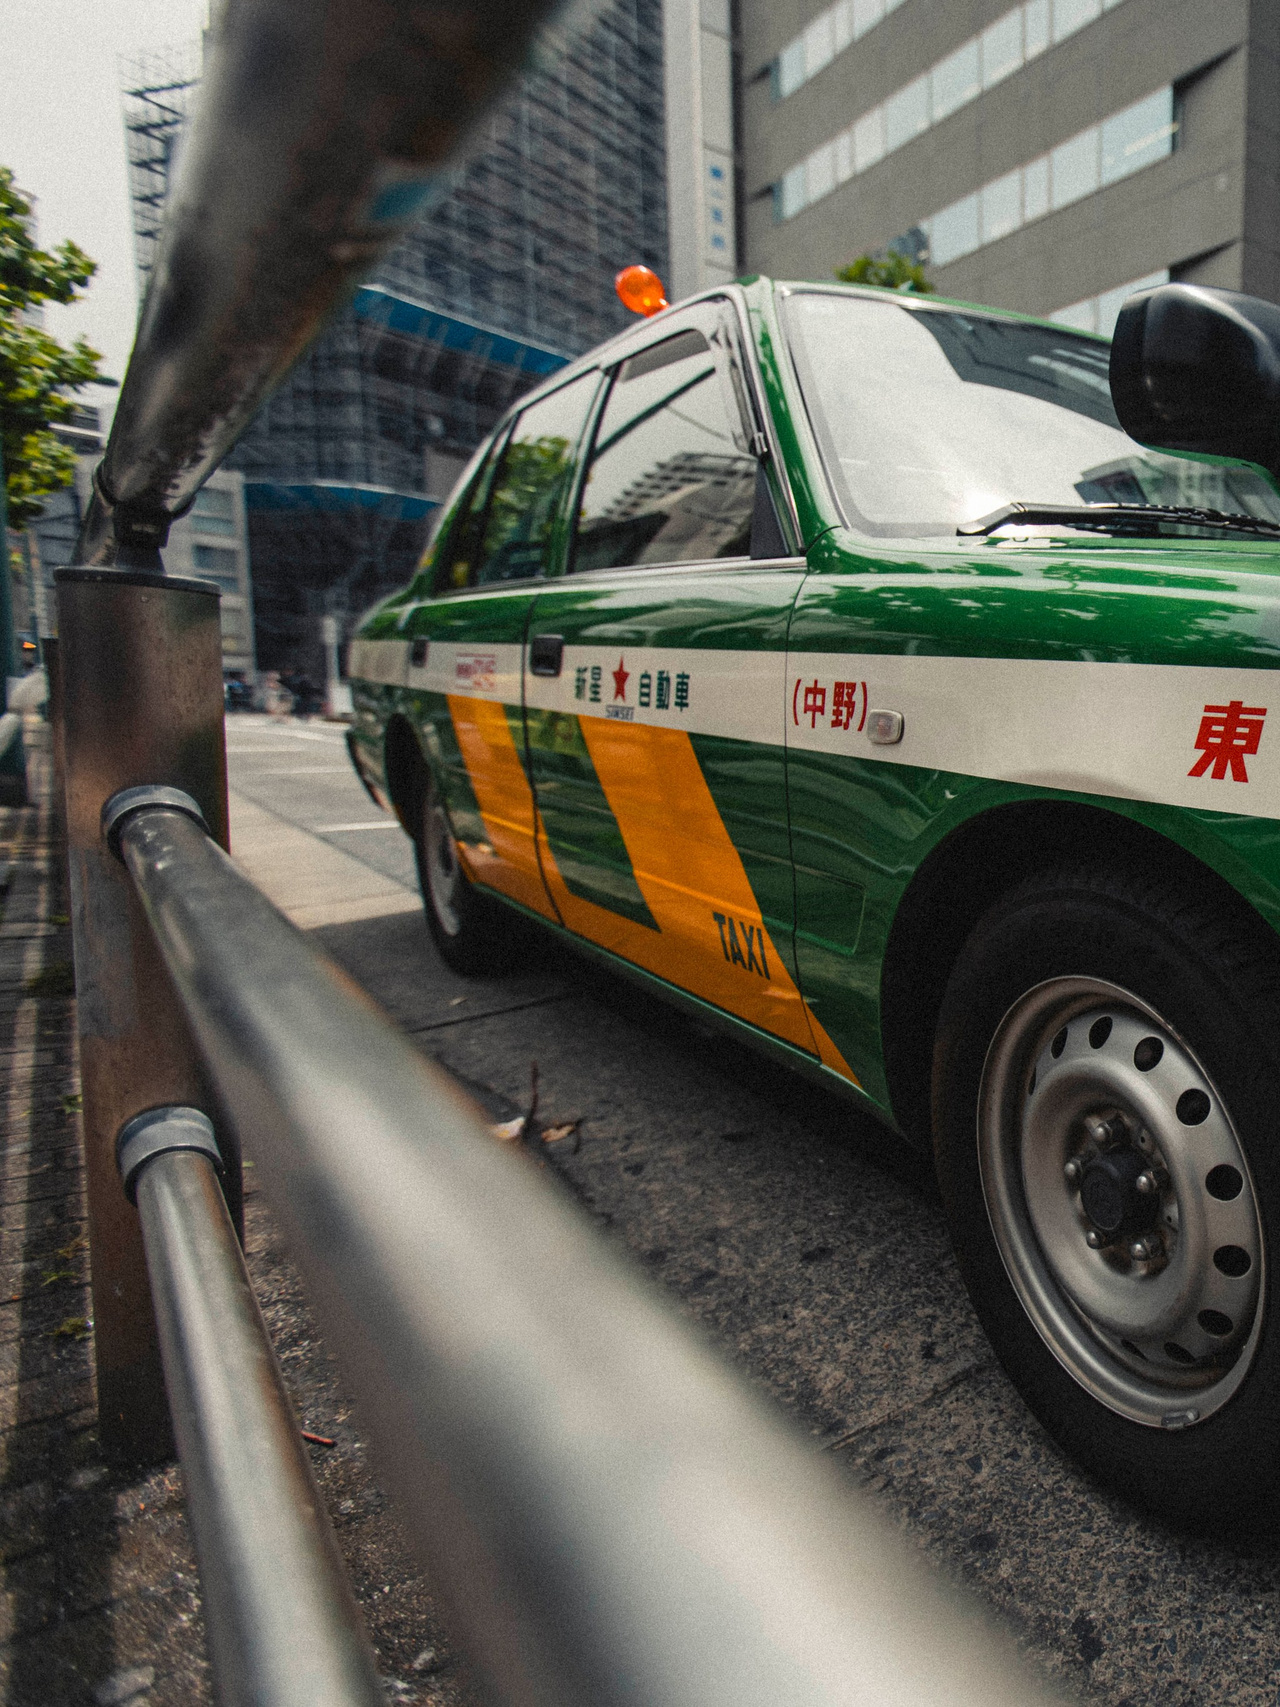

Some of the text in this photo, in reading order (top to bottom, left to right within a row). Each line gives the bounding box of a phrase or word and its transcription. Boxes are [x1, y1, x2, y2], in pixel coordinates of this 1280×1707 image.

[638, 669, 691, 712] 自動車
[792, 678, 868, 732] (中野)
[712, 910, 771, 981] TAXI
